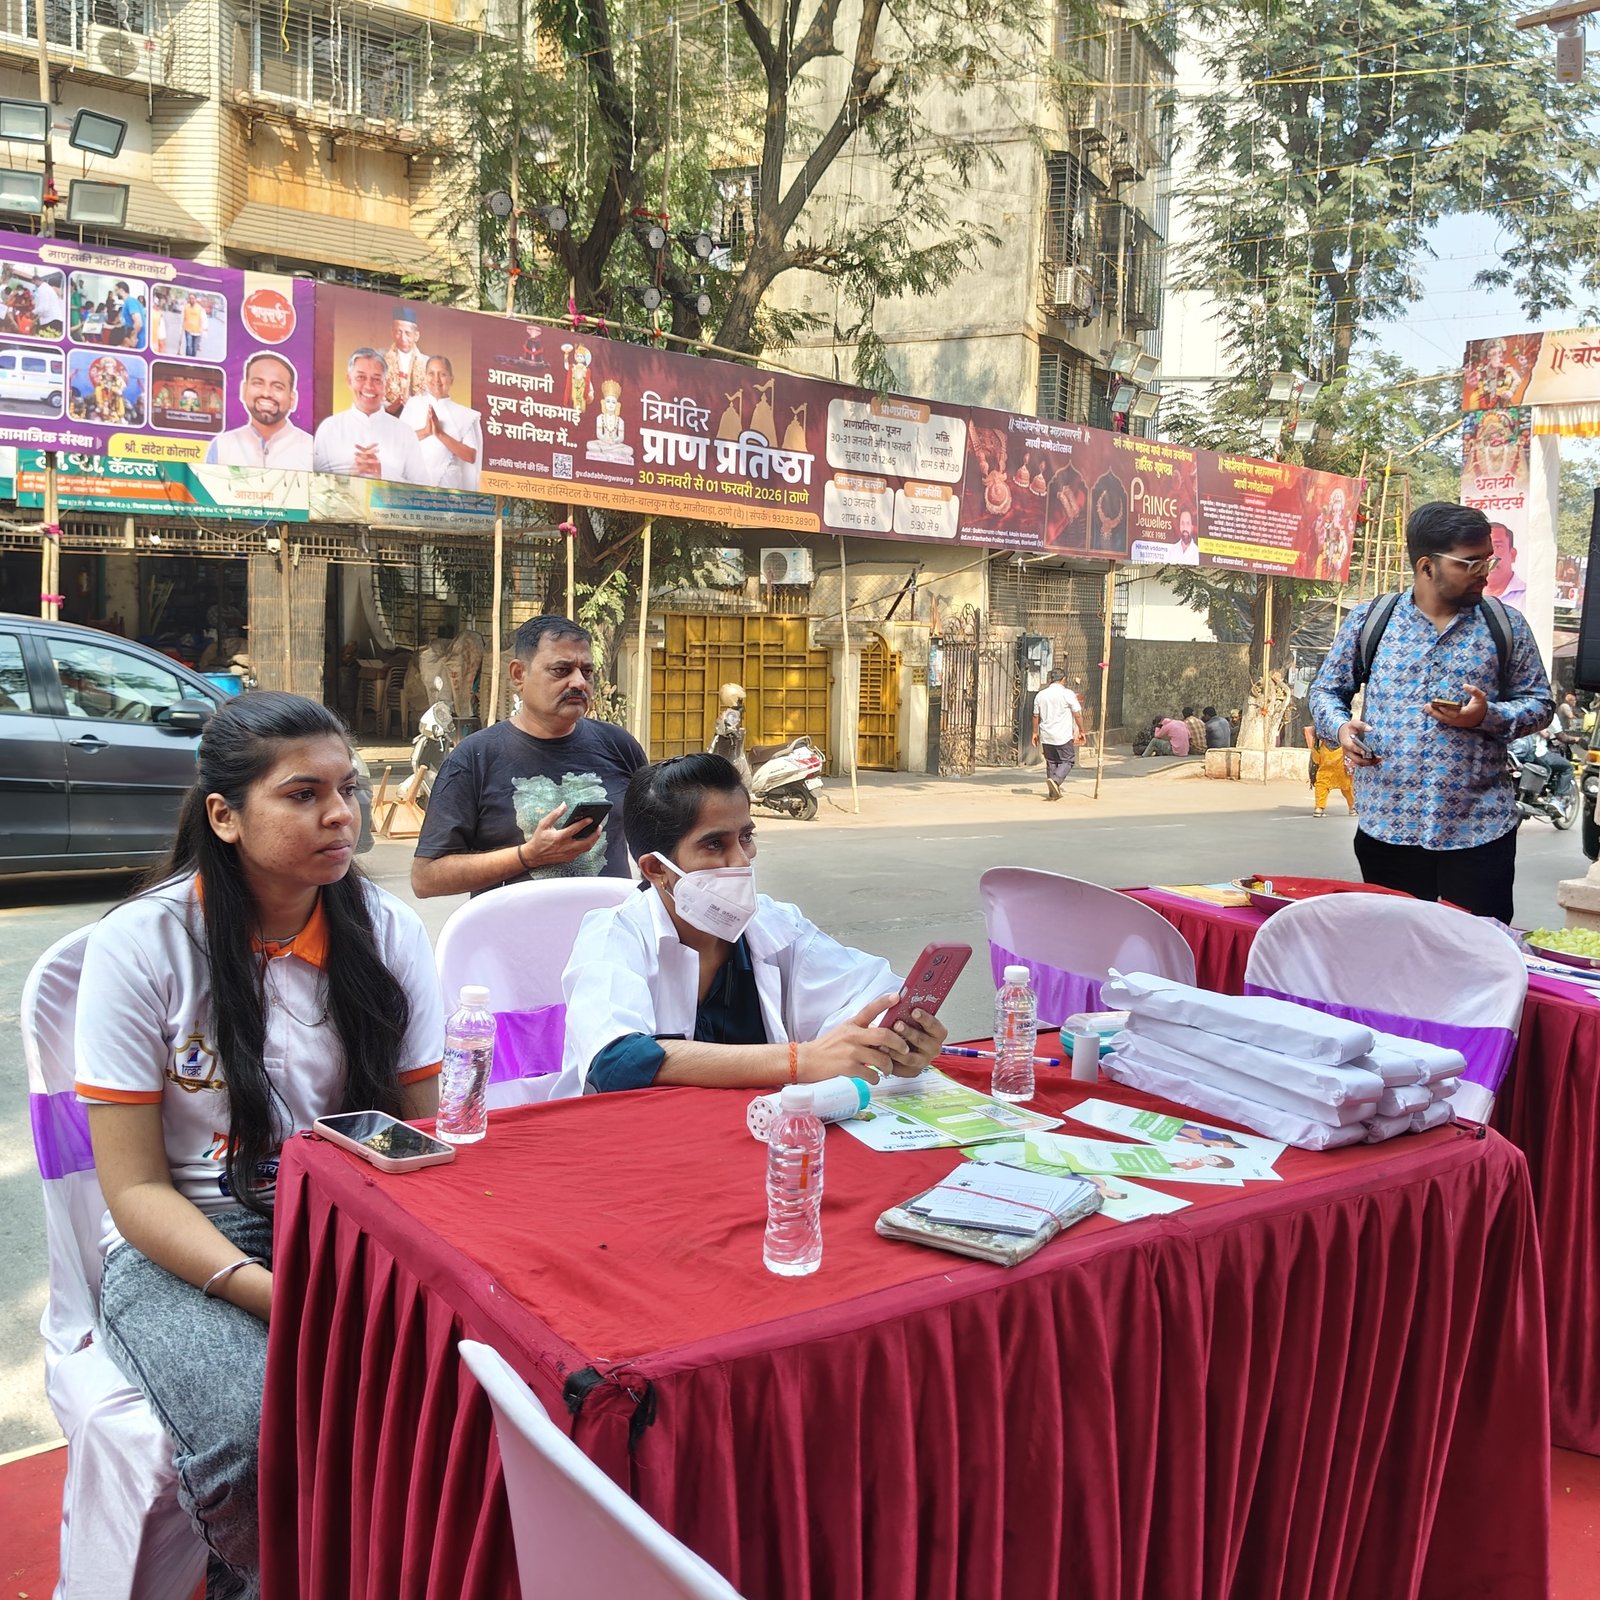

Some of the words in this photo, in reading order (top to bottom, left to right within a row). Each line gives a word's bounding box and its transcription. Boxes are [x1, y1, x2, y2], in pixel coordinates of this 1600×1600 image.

[487, 368, 555, 394] आत्मज्ञानी
[486, 394, 519, 416] पूज्य
[518, 396, 583, 426] दीपकभाई
[640, 390, 712, 433] त्रिमंदिर
[58, 430, 94, 448] संस्था
[486, 416, 504, 436] के
[503, 421, 555, 445] सानिध्य
[141, 444, 165, 457] संदेश
[639, 427, 711, 471] प्राण
[713, 429, 816, 486] प्रतिष्ठा
[575, 470, 635, 485] gv.dadabhagwan.org
[638, 470, 656, 485] 30
[656, 472, 692, 490] जनवरी
[693, 473, 705, 491] से
[705, 480, 719, 493] 01
[720, 481, 754, 499] फरवरी
[754, 487, 783, 502] 2026
[788, 488, 810, 505] ठाणे
[582, 487, 593, 499] के
[717, 506, 733, 517] ठाणे
[772, 514, 794, 525] 93235
[795, 516, 817, 527] 28901
[842, 496, 853, 507] 30
[853, 496, 877, 510] जनवरी
[911, 504, 920, 514] 30
[1135, 513, 1172, 530] Jewellers
[1141, 530, 1155, 539] SINCE
